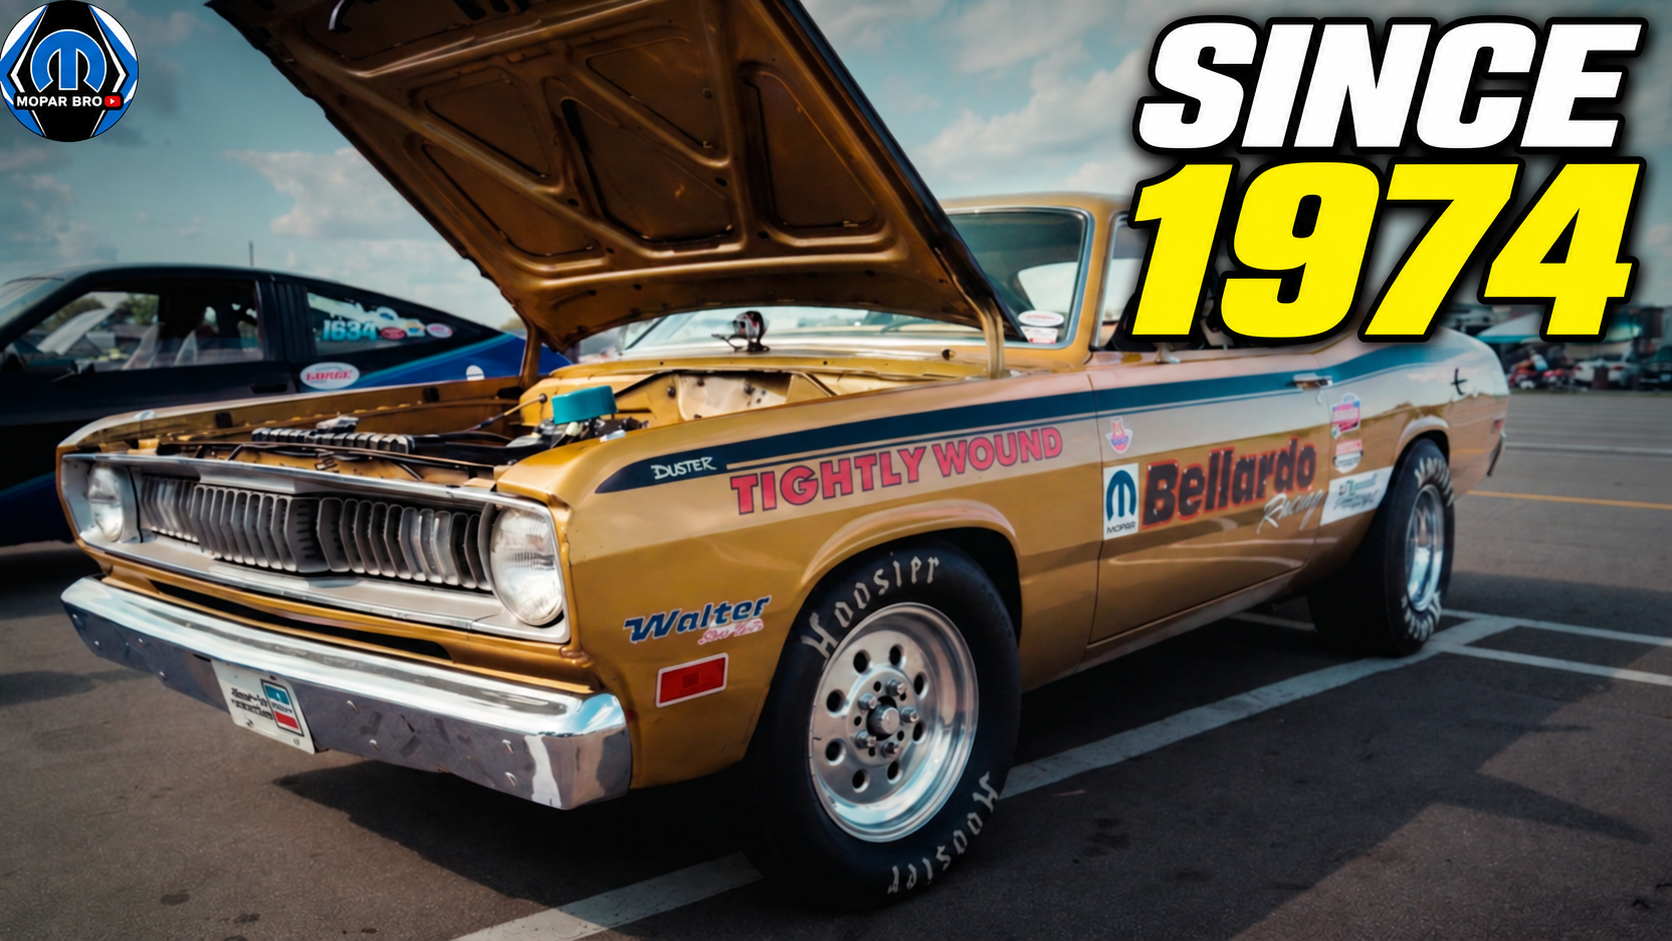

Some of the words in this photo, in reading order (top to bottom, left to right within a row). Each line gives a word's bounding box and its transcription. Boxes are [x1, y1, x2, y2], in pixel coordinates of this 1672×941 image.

[322, 319, 377, 341] 1634
[650, 456, 718, 480] DUSTER
[729, 445, 926, 516] TIGHTLY
[931, 426, 1063, 478] WOUND
[1141, 435, 1317, 530] Bellardo
[1106, 520, 1137, 535] MOPAR
[622, 594, 773, 645] Walter
[800, 551, 940, 672] Hoosier
[886, 770, 1000, 895] Hoosier
